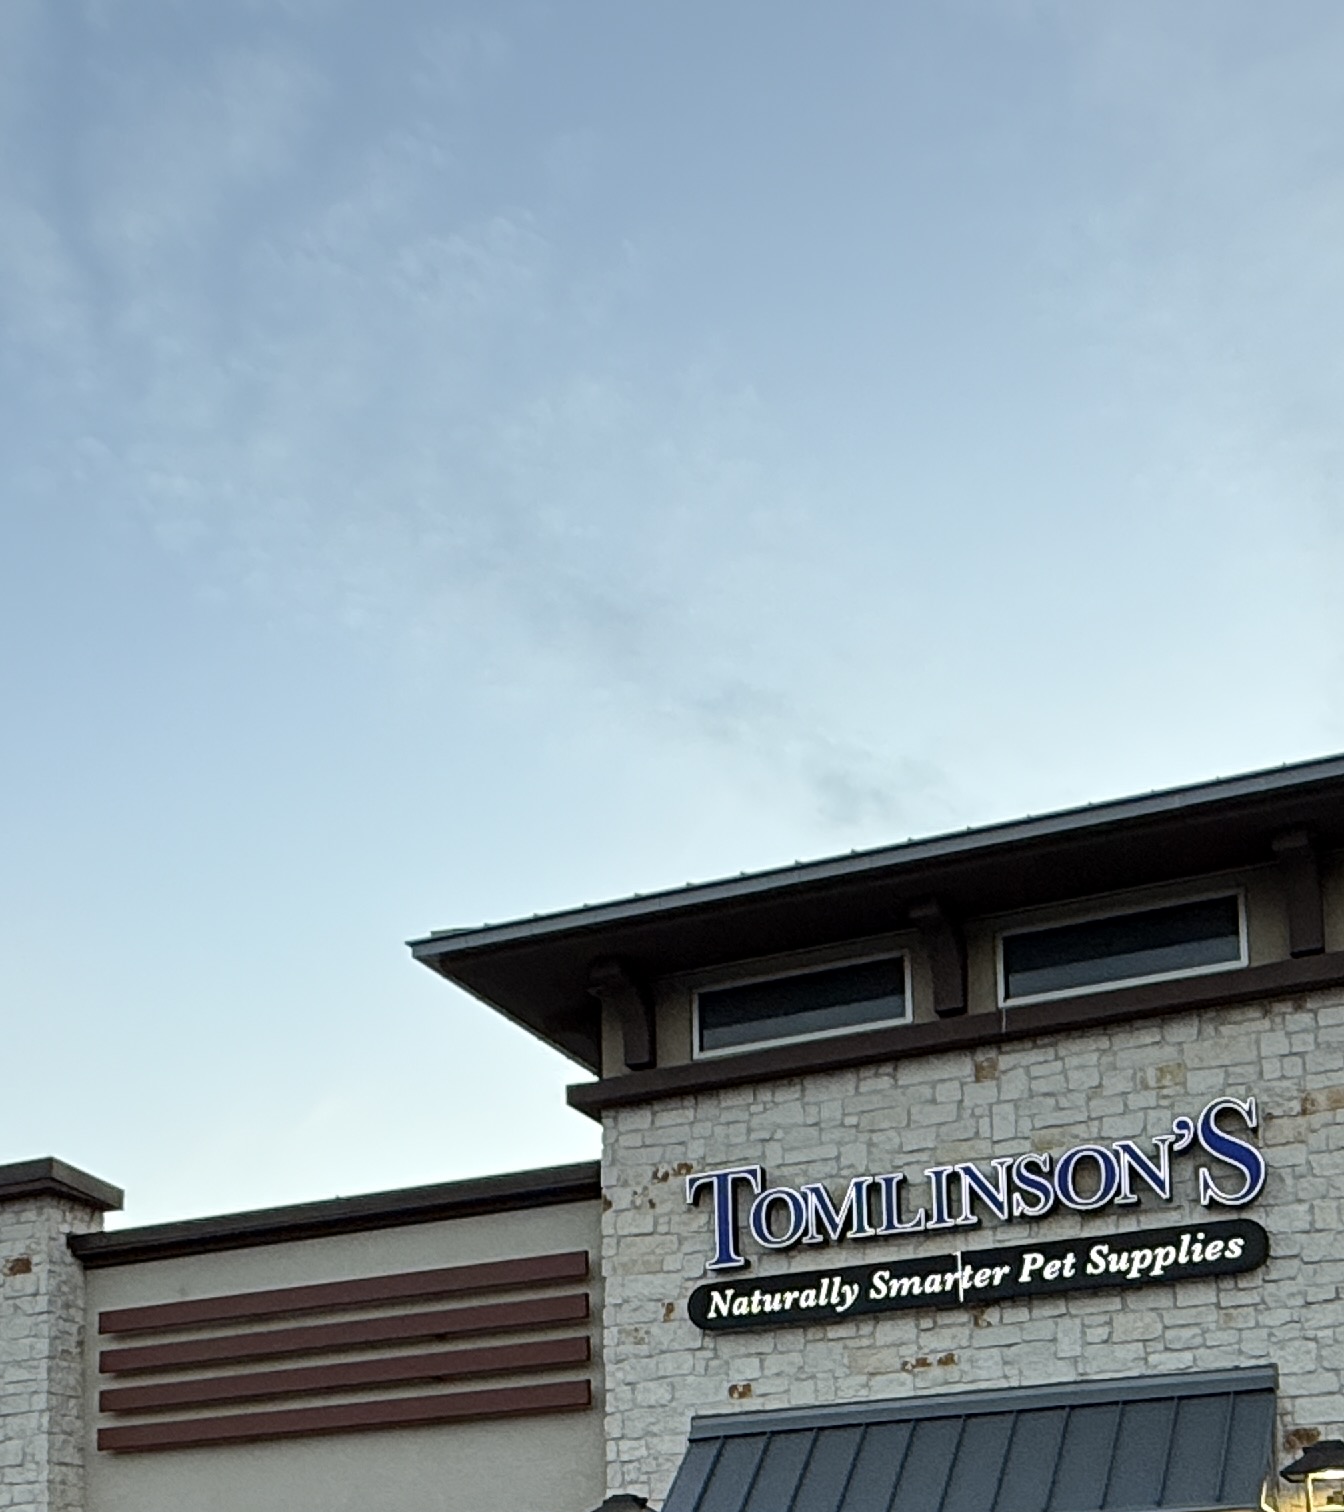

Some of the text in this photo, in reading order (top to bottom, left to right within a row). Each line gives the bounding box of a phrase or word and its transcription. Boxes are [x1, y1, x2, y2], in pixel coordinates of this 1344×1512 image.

[686, 1097, 1266, 1270] TOMLINSON'S
[707, 1232, 1246, 1318] Naturally Smarter Pet Supplies
